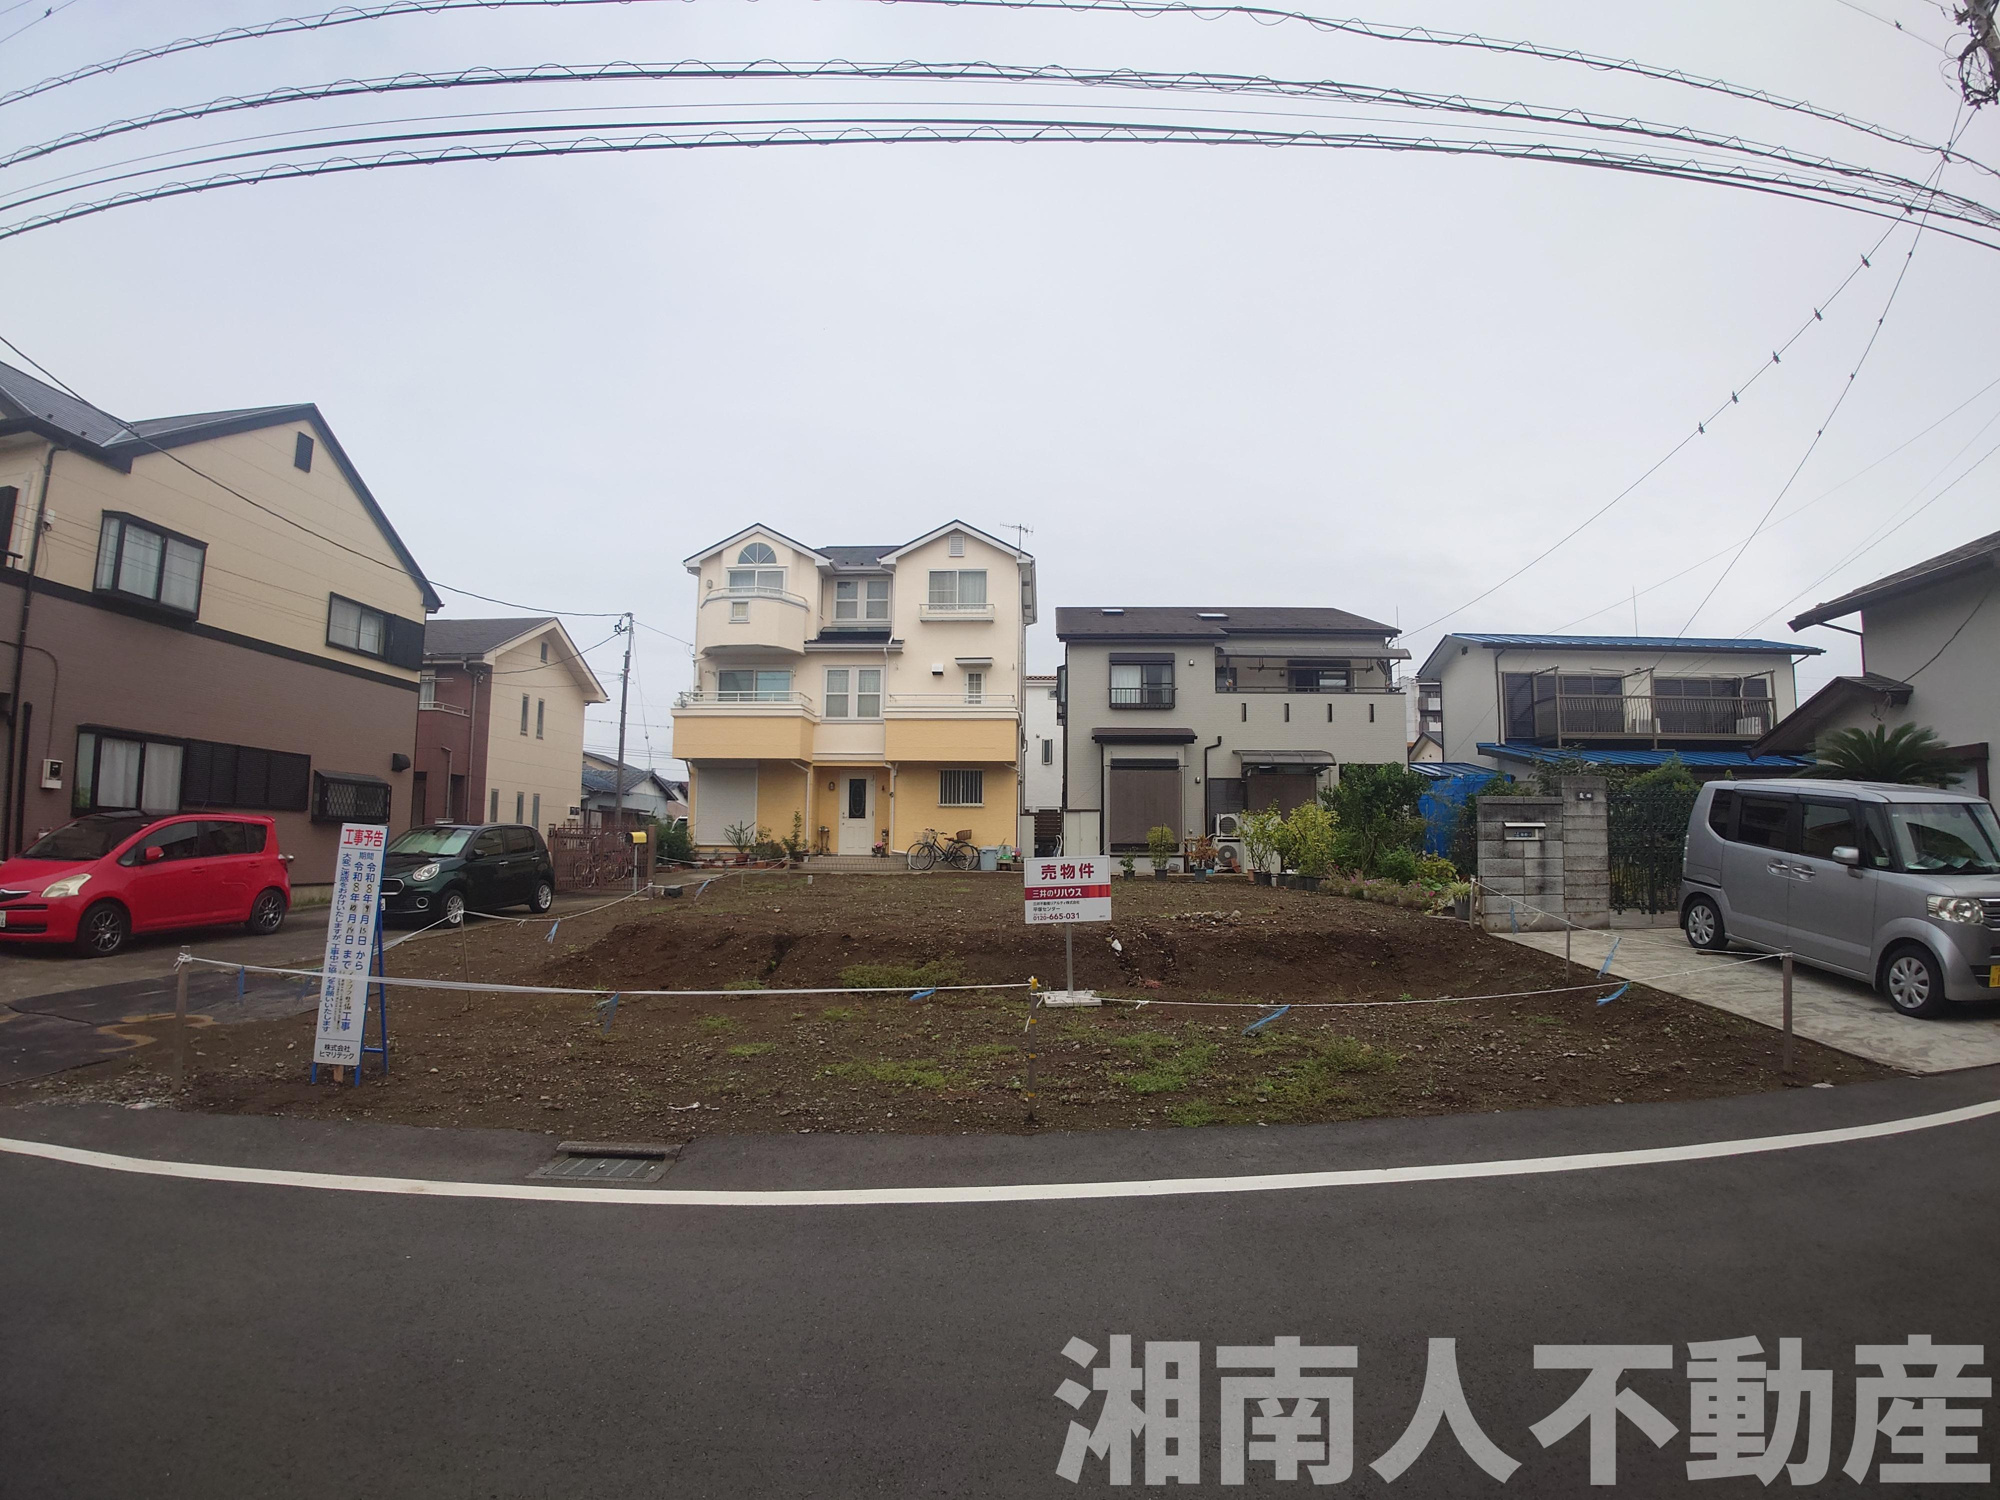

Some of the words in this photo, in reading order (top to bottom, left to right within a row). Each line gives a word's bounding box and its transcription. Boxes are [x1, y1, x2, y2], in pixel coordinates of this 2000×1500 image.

[343, 829, 383, 847] 工事予告
[359, 852, 374, 861] 期間
[1041, 863, 1095, 880] 売物件
[1032, 888, 1082, 898] 三井のリハウス
[324, 1044, 351, 1052] 株式会社
[319, 1051, 355, 1060] ヒマリテック
